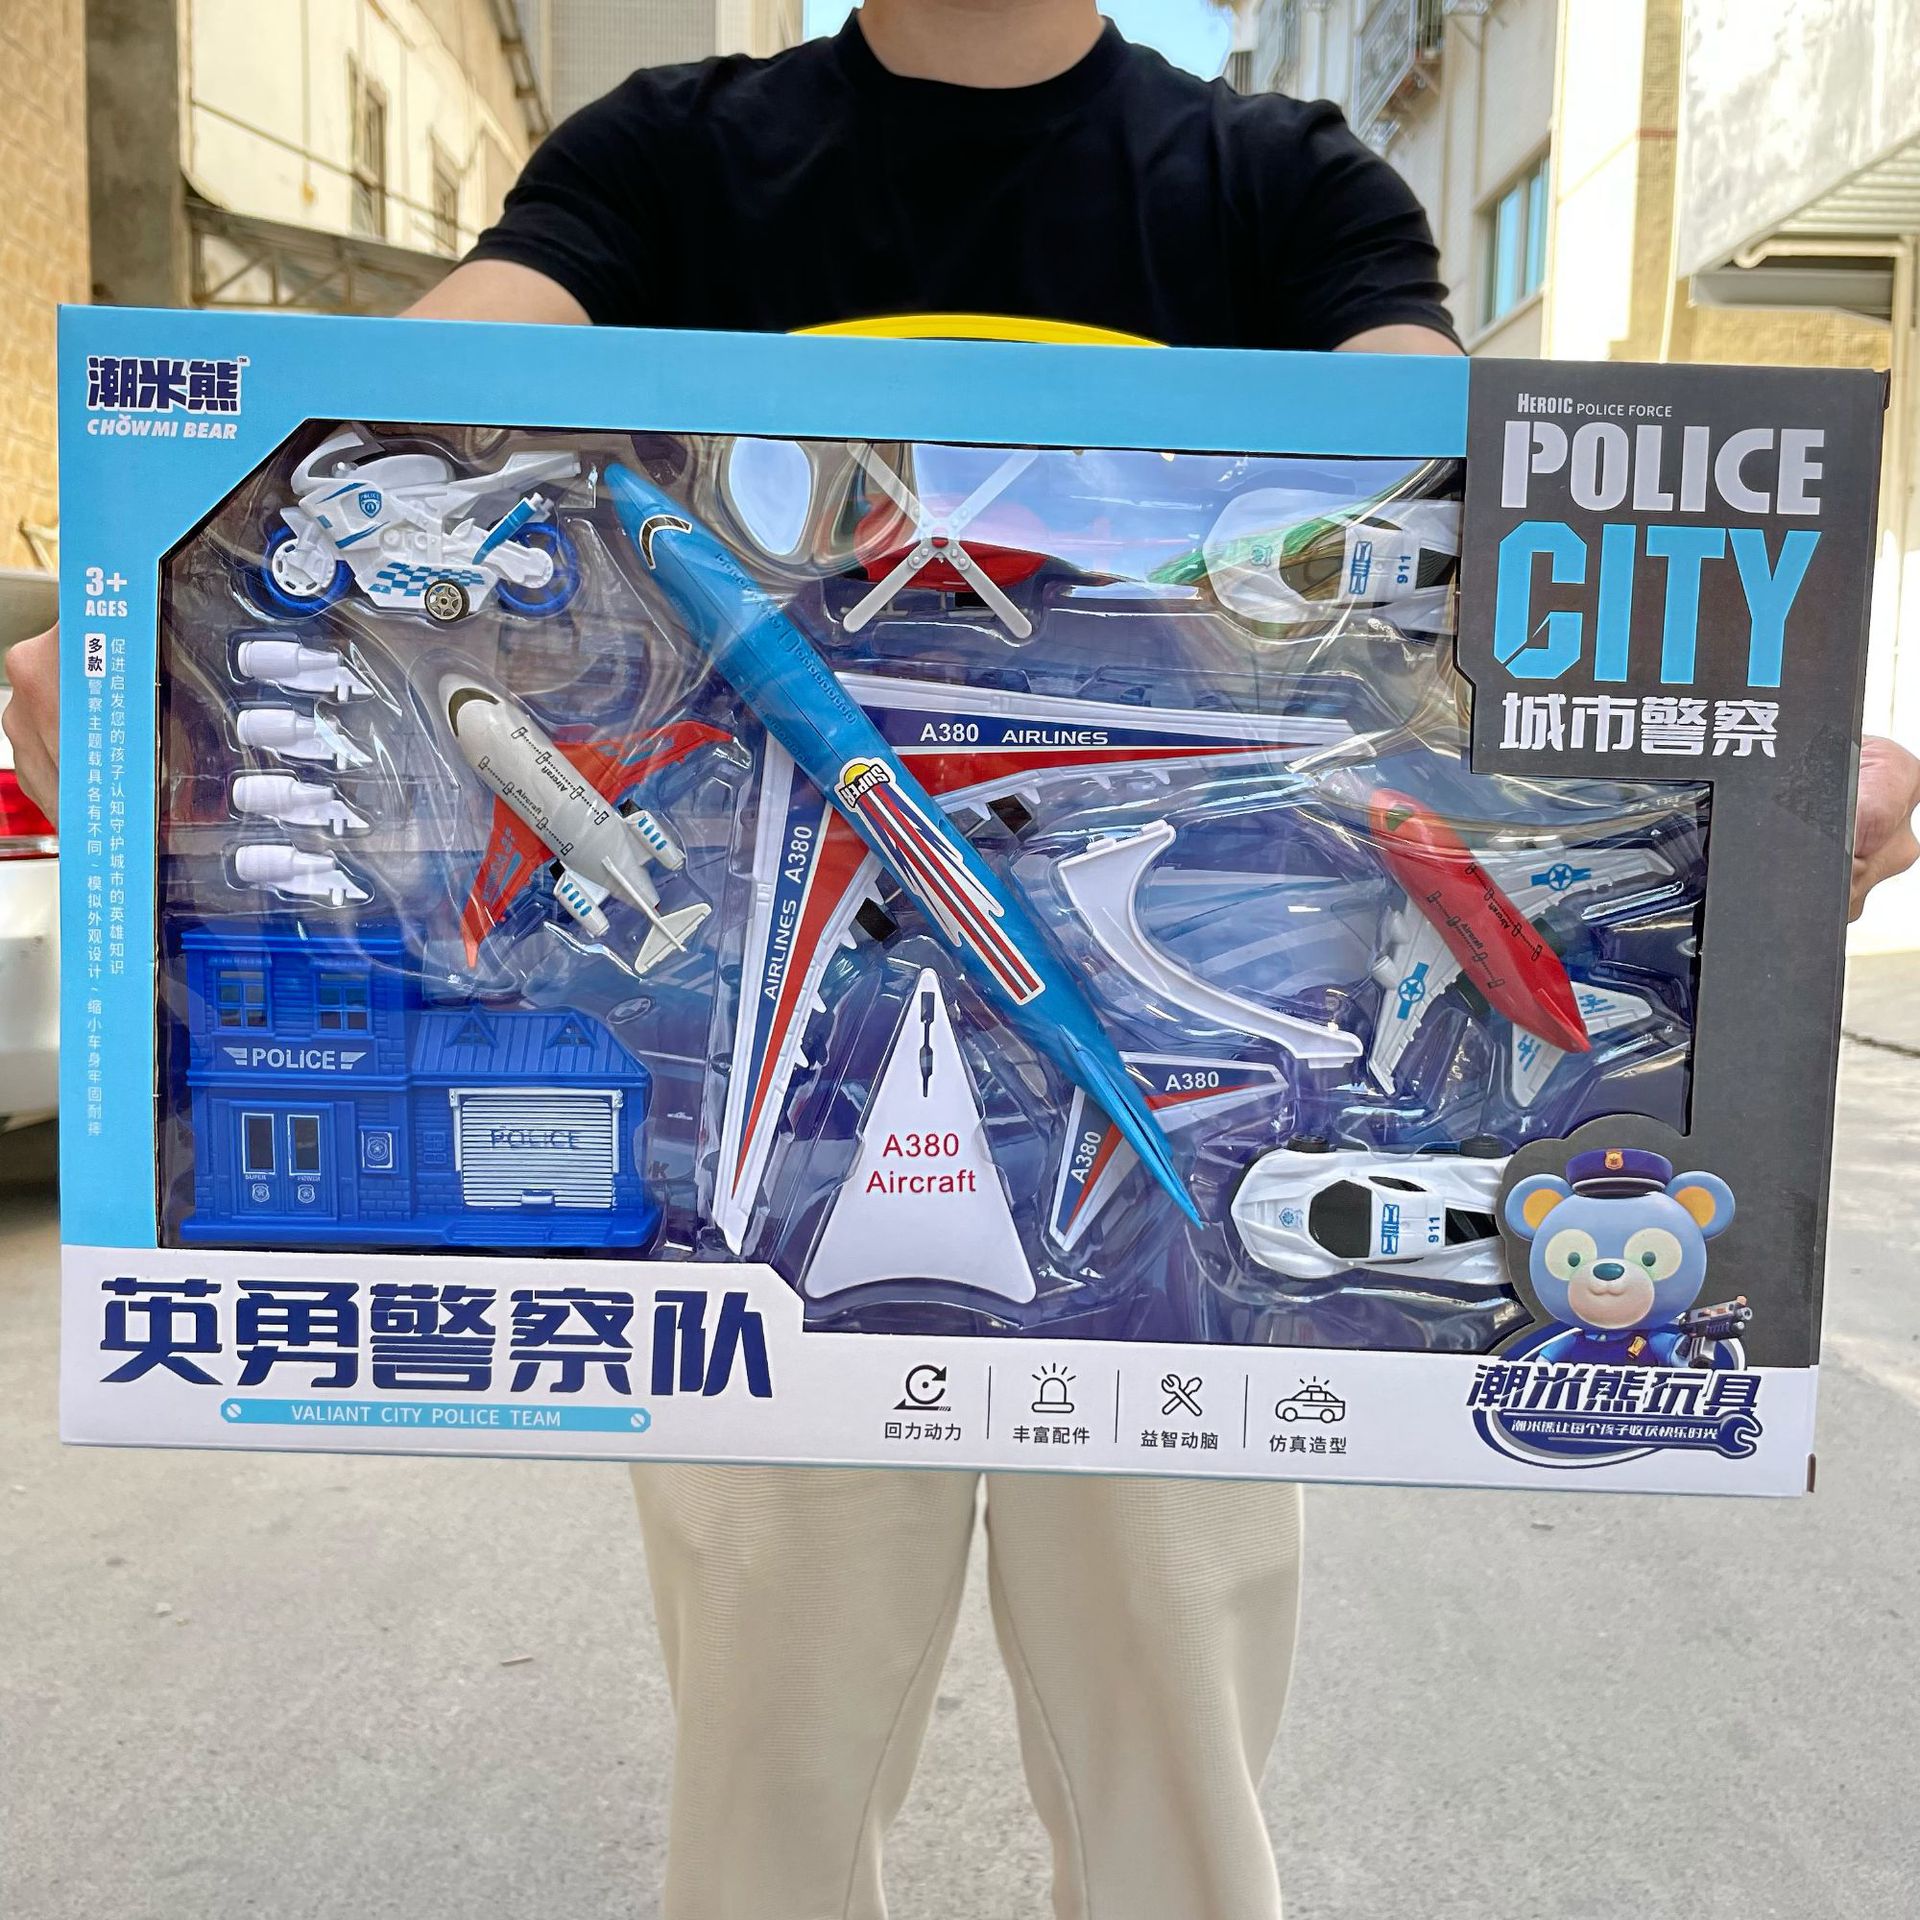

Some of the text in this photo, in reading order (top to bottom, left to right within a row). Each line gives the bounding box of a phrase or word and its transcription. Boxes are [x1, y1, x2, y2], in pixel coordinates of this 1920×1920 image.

[87, 356, 239, 413] 潮米熊
[1517, 393, 1673, 418] HEROIC POLICE FORCE
[183, 421, 238, 440] BEAR
[1500, 420, 1826, 516] POLICE
[85, 567, 128, 596] 3+
[1397, 555, 1412, 584] 911
[85, 599, 128, 617] AGES
[1493, 520, 1822, 688] CITY
[919, 722, 1109, 745] A380 AIRLINES
[1499, 693, 1780, 759] 城市警察
[541, 765, 569, 793] Aircraft
[839, 764, 890, 807] SUPER
[515, 788, 543, 816] Aircraft
[764, 826, 813, 1001] AIRLINES A380
[252, 1047, 336, 1070] POLICE
[1165, 1071, 1220, 1092] A380
[882, 1132, 959, 1158] A380
[1070, 1131, 1102, 1184] A380
[865, 1168, 976, 1194] Aircraft
[1428, 1216, 1440, 1243] 911
[99, 1276, 774, 1400] 英勇警察队
[1466, 1363, 1763, 1418] 潮米熊玩具
[291, 1404, 561, 1427] VALIANT CITY POLICE TEAM
[884, 1421, 963, 1442] 回力动力
[1012, 1425, 1091, 1446] 丰富配件
[1140, 1429, 1219, 1451] 益智动脑
[1269, 1433, 1348, 1455] 仿真造型
